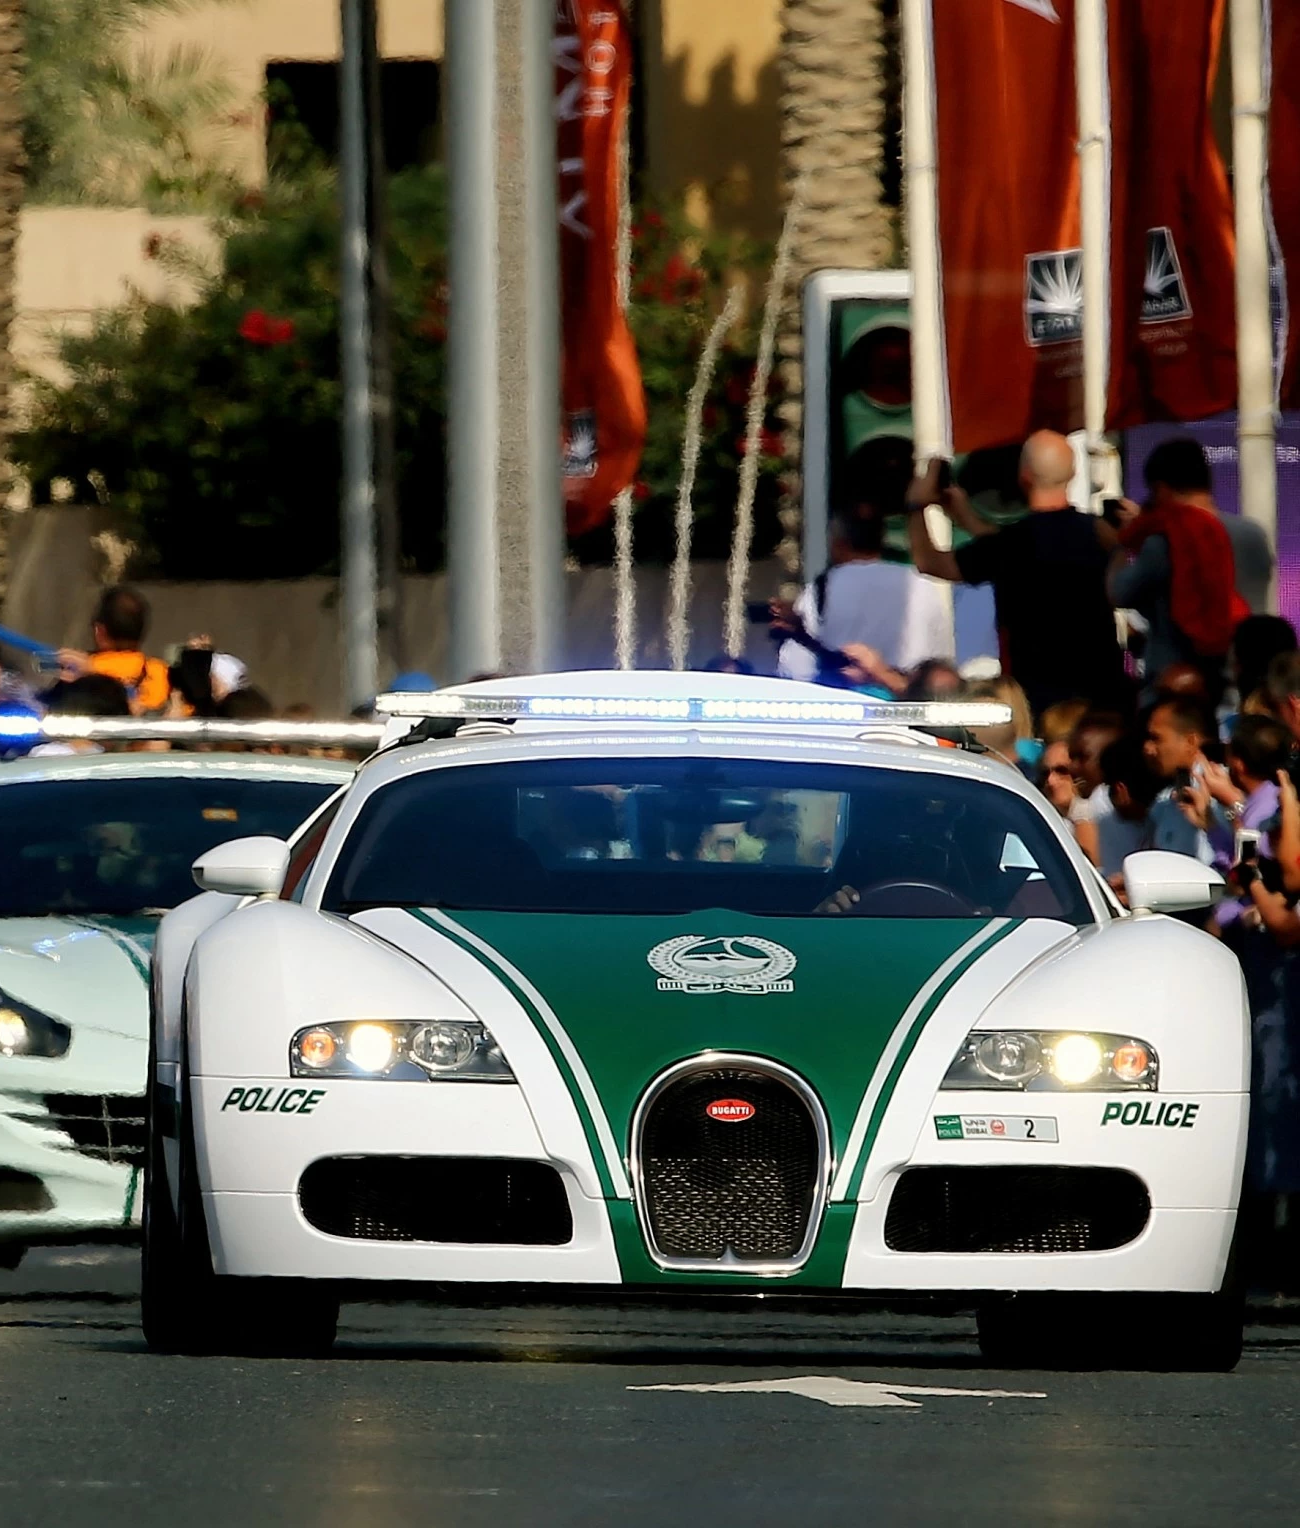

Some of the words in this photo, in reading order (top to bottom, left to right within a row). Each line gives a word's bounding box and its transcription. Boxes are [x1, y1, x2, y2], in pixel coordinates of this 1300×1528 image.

[221, 1086, 328, 1115] POLICE
[711, 1106, 750, 1115] BUGATTI
[1100, 1101, 1200, 1128] POLICE
[939, 1128, 962, 1137] POLICE
[965, 1127, 988, 1135] DUBAI
[1024, 1119, 1036, 1139] 2
